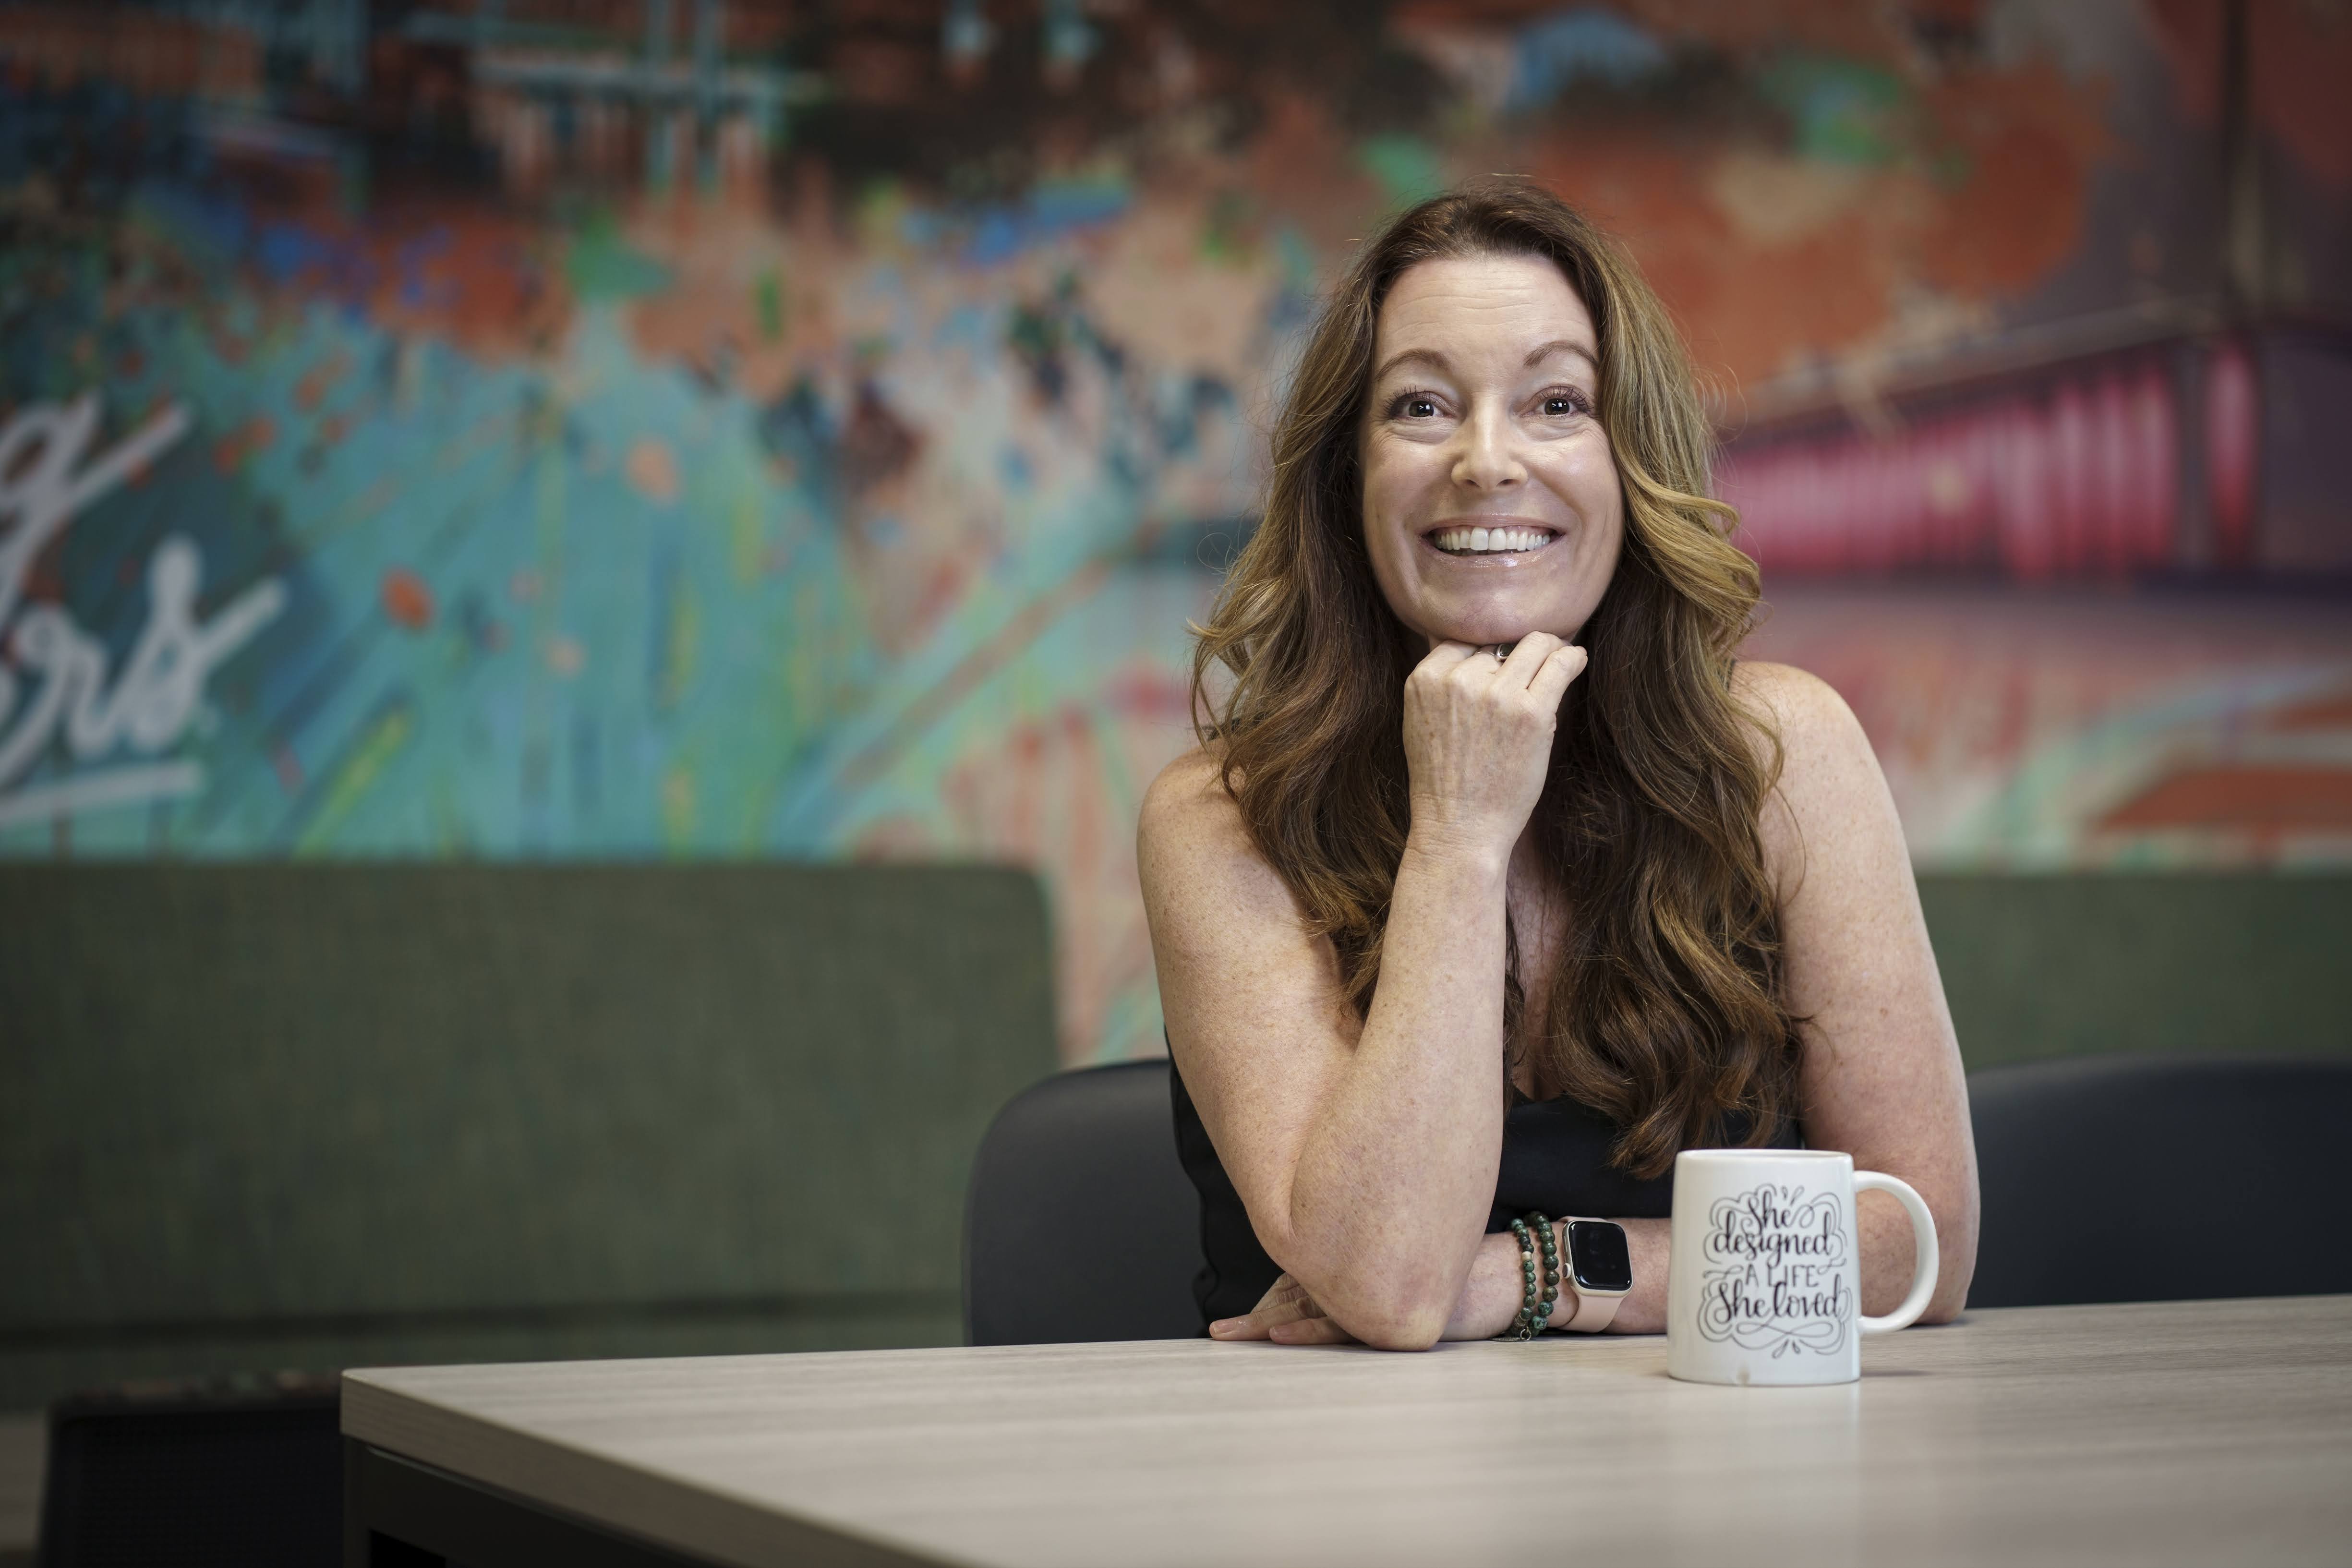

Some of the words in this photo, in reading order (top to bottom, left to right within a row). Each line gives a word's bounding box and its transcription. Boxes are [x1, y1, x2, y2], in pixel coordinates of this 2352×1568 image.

[1741, 1191, 1791, 1237] She
[1714, 1210, 1833, 1268] designed
[1714, 1279, 1771, 1324] She
[1773, 1274, 1841, 1318] loved
[1745, 1263, 1759, 1288] A
[1768, 1265, 1819, 1288] LIFE
